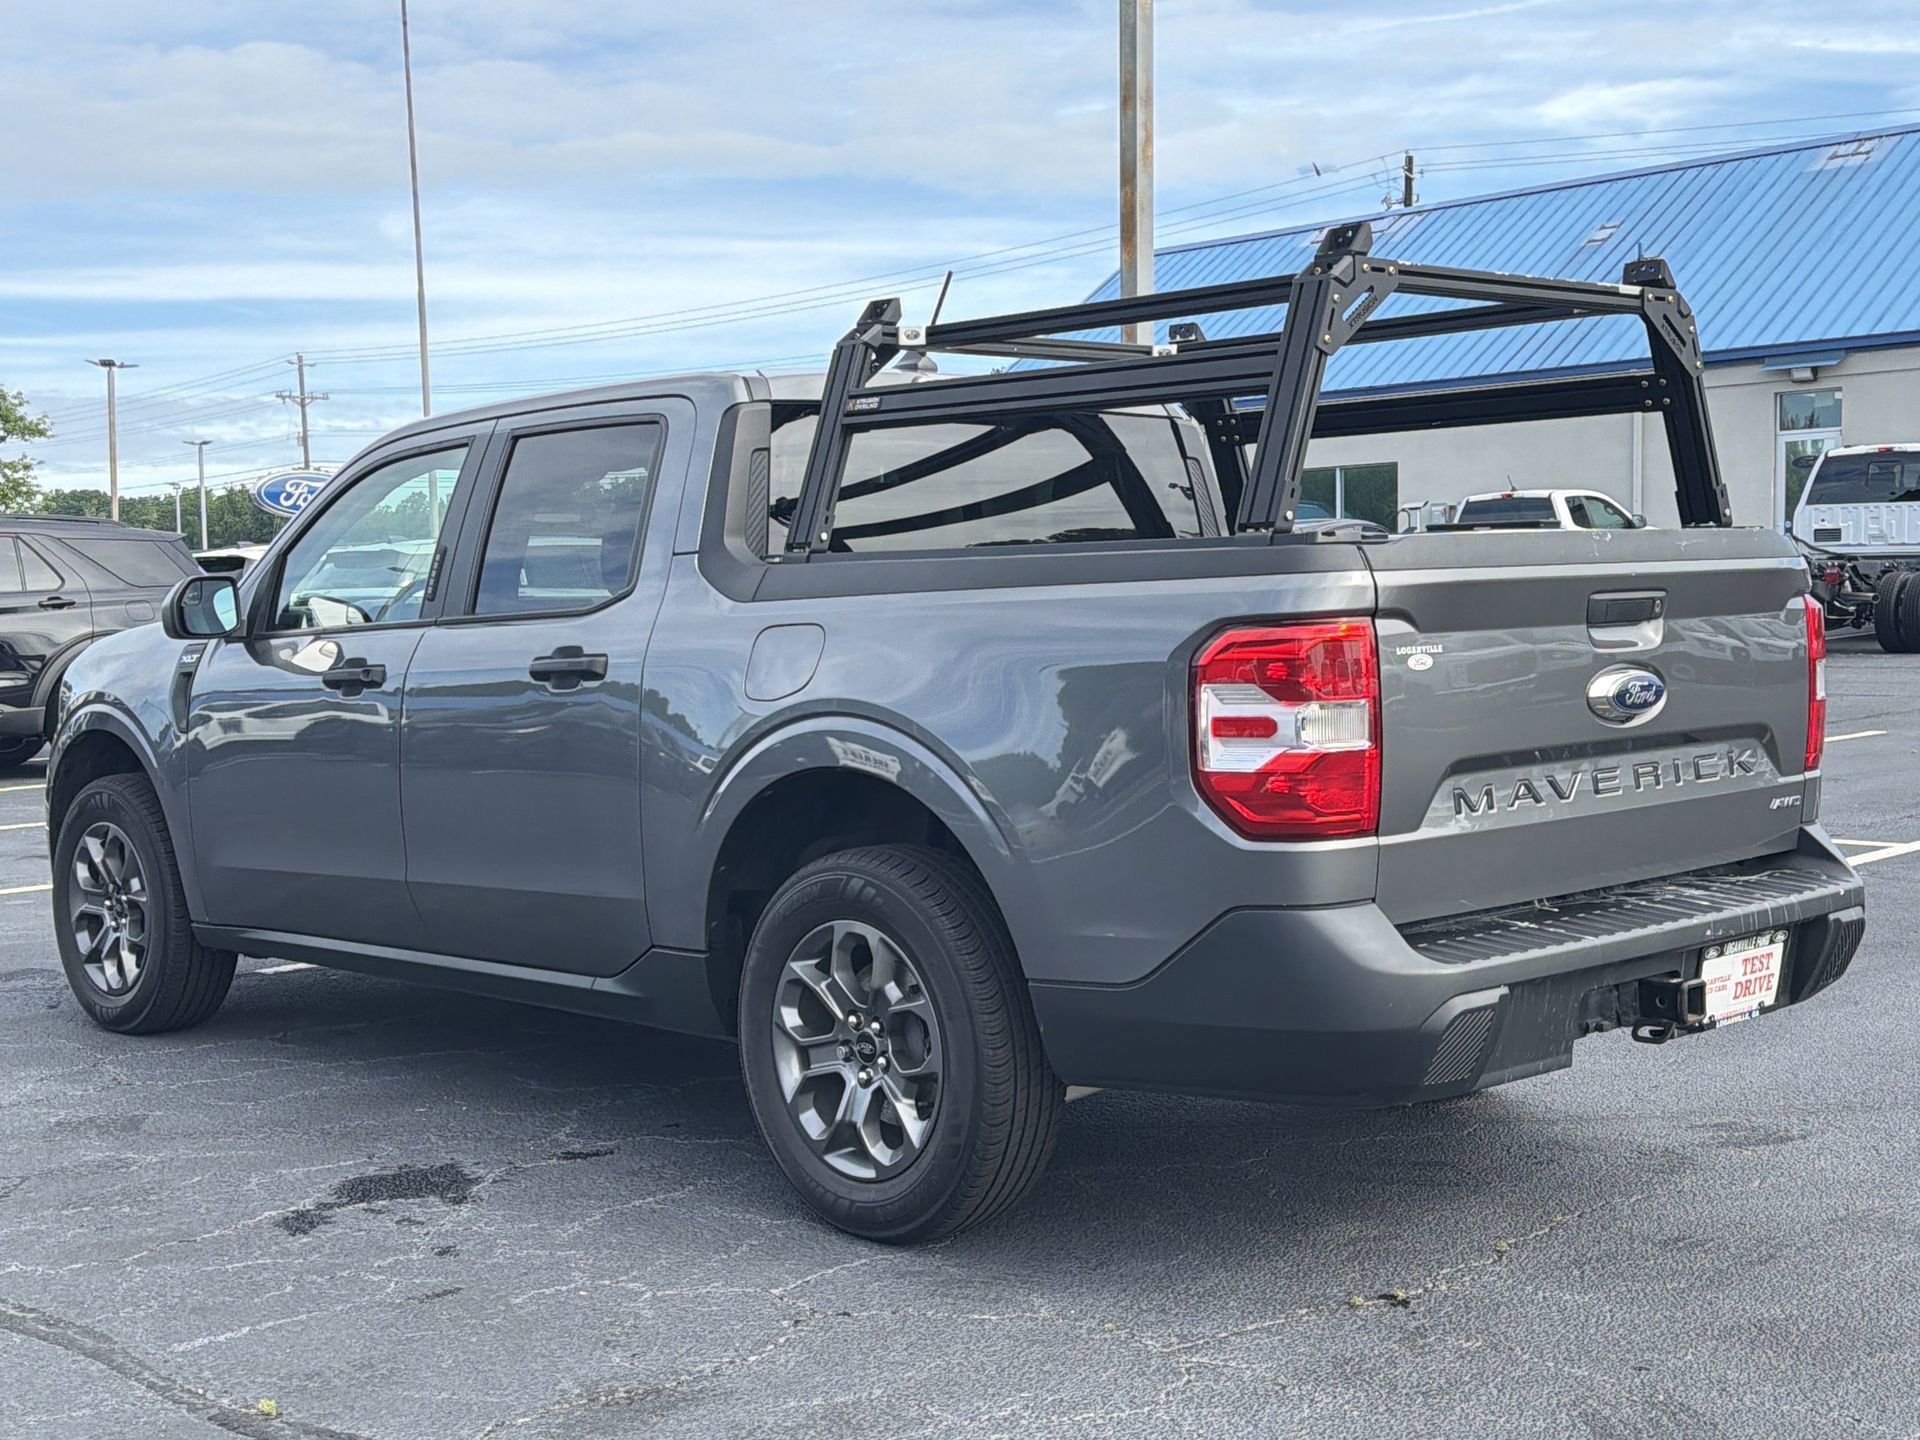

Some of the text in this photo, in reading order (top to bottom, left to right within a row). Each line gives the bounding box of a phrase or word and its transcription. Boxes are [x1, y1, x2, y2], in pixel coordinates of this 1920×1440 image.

[279, 479, 325, 507] Fo
[1625, 680, 1657, 705] Ford
[1453, 749, 1754, 817] MAVERICK
[1742, 952, 1774, 976] TEST
[1732, 973, 1775, 1001] DRIVE
